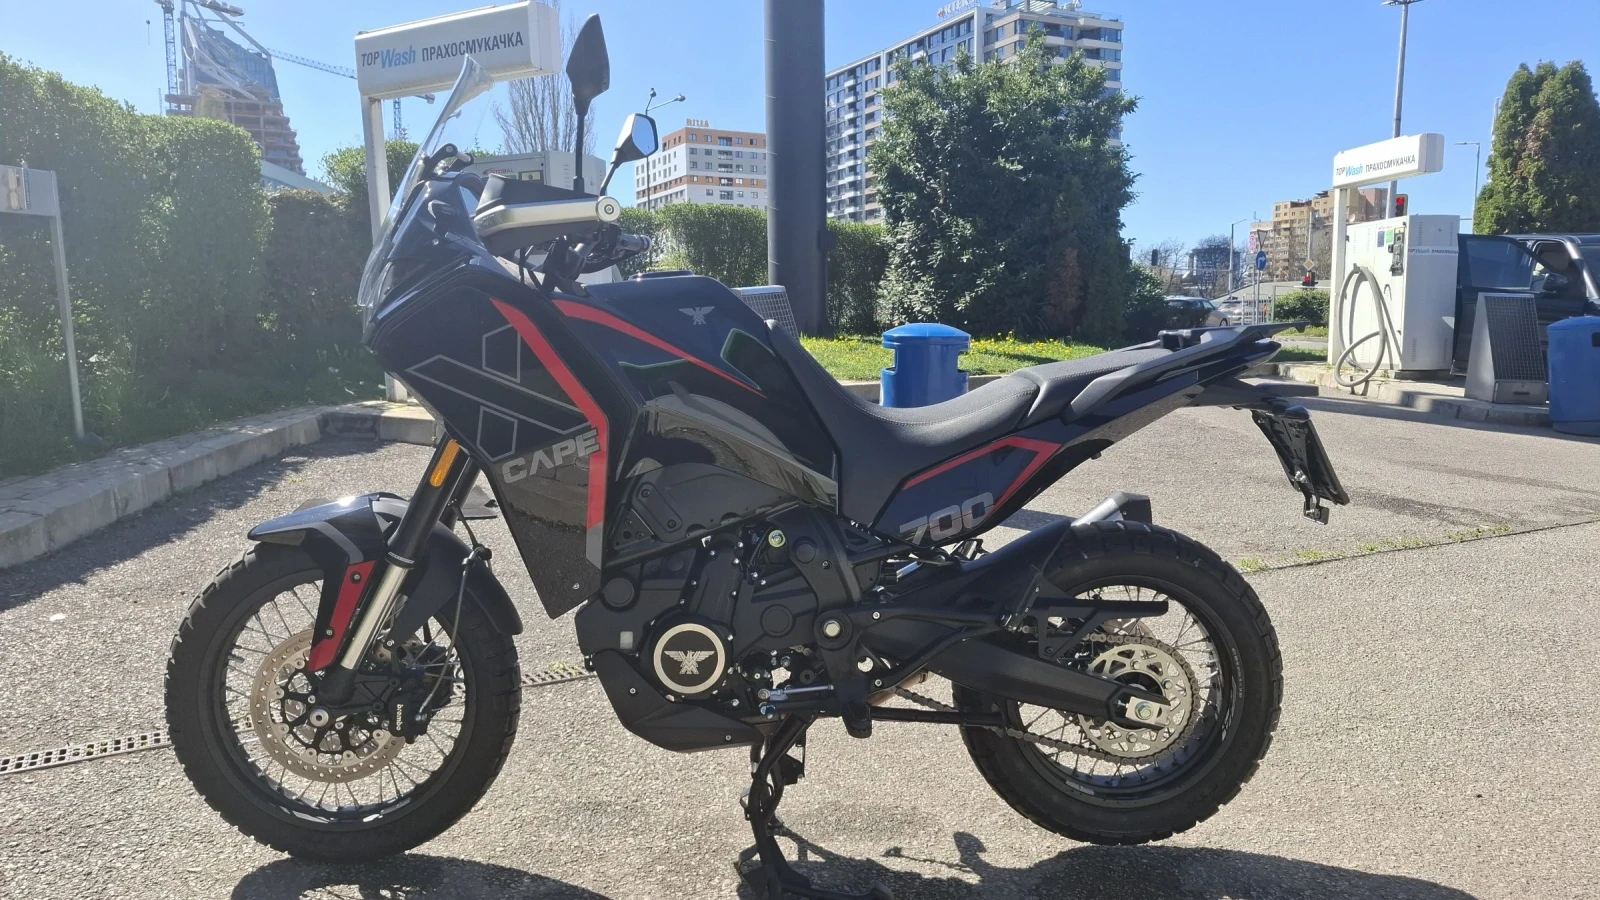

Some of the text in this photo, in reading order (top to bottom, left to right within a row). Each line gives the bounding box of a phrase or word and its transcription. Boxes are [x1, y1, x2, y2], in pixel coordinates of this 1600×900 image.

[422, 31, 523, 62] ПРАХОСМУКАЧКА
[686, 118, 709, 127] BILLA
[1365, 154, 1415, 173] ПРАХОСМУКАЧКА
[502, 429, 599, 483] CAPE
[900, 492, 994, 545] 700
[396, 703, 404, 731] brembo
